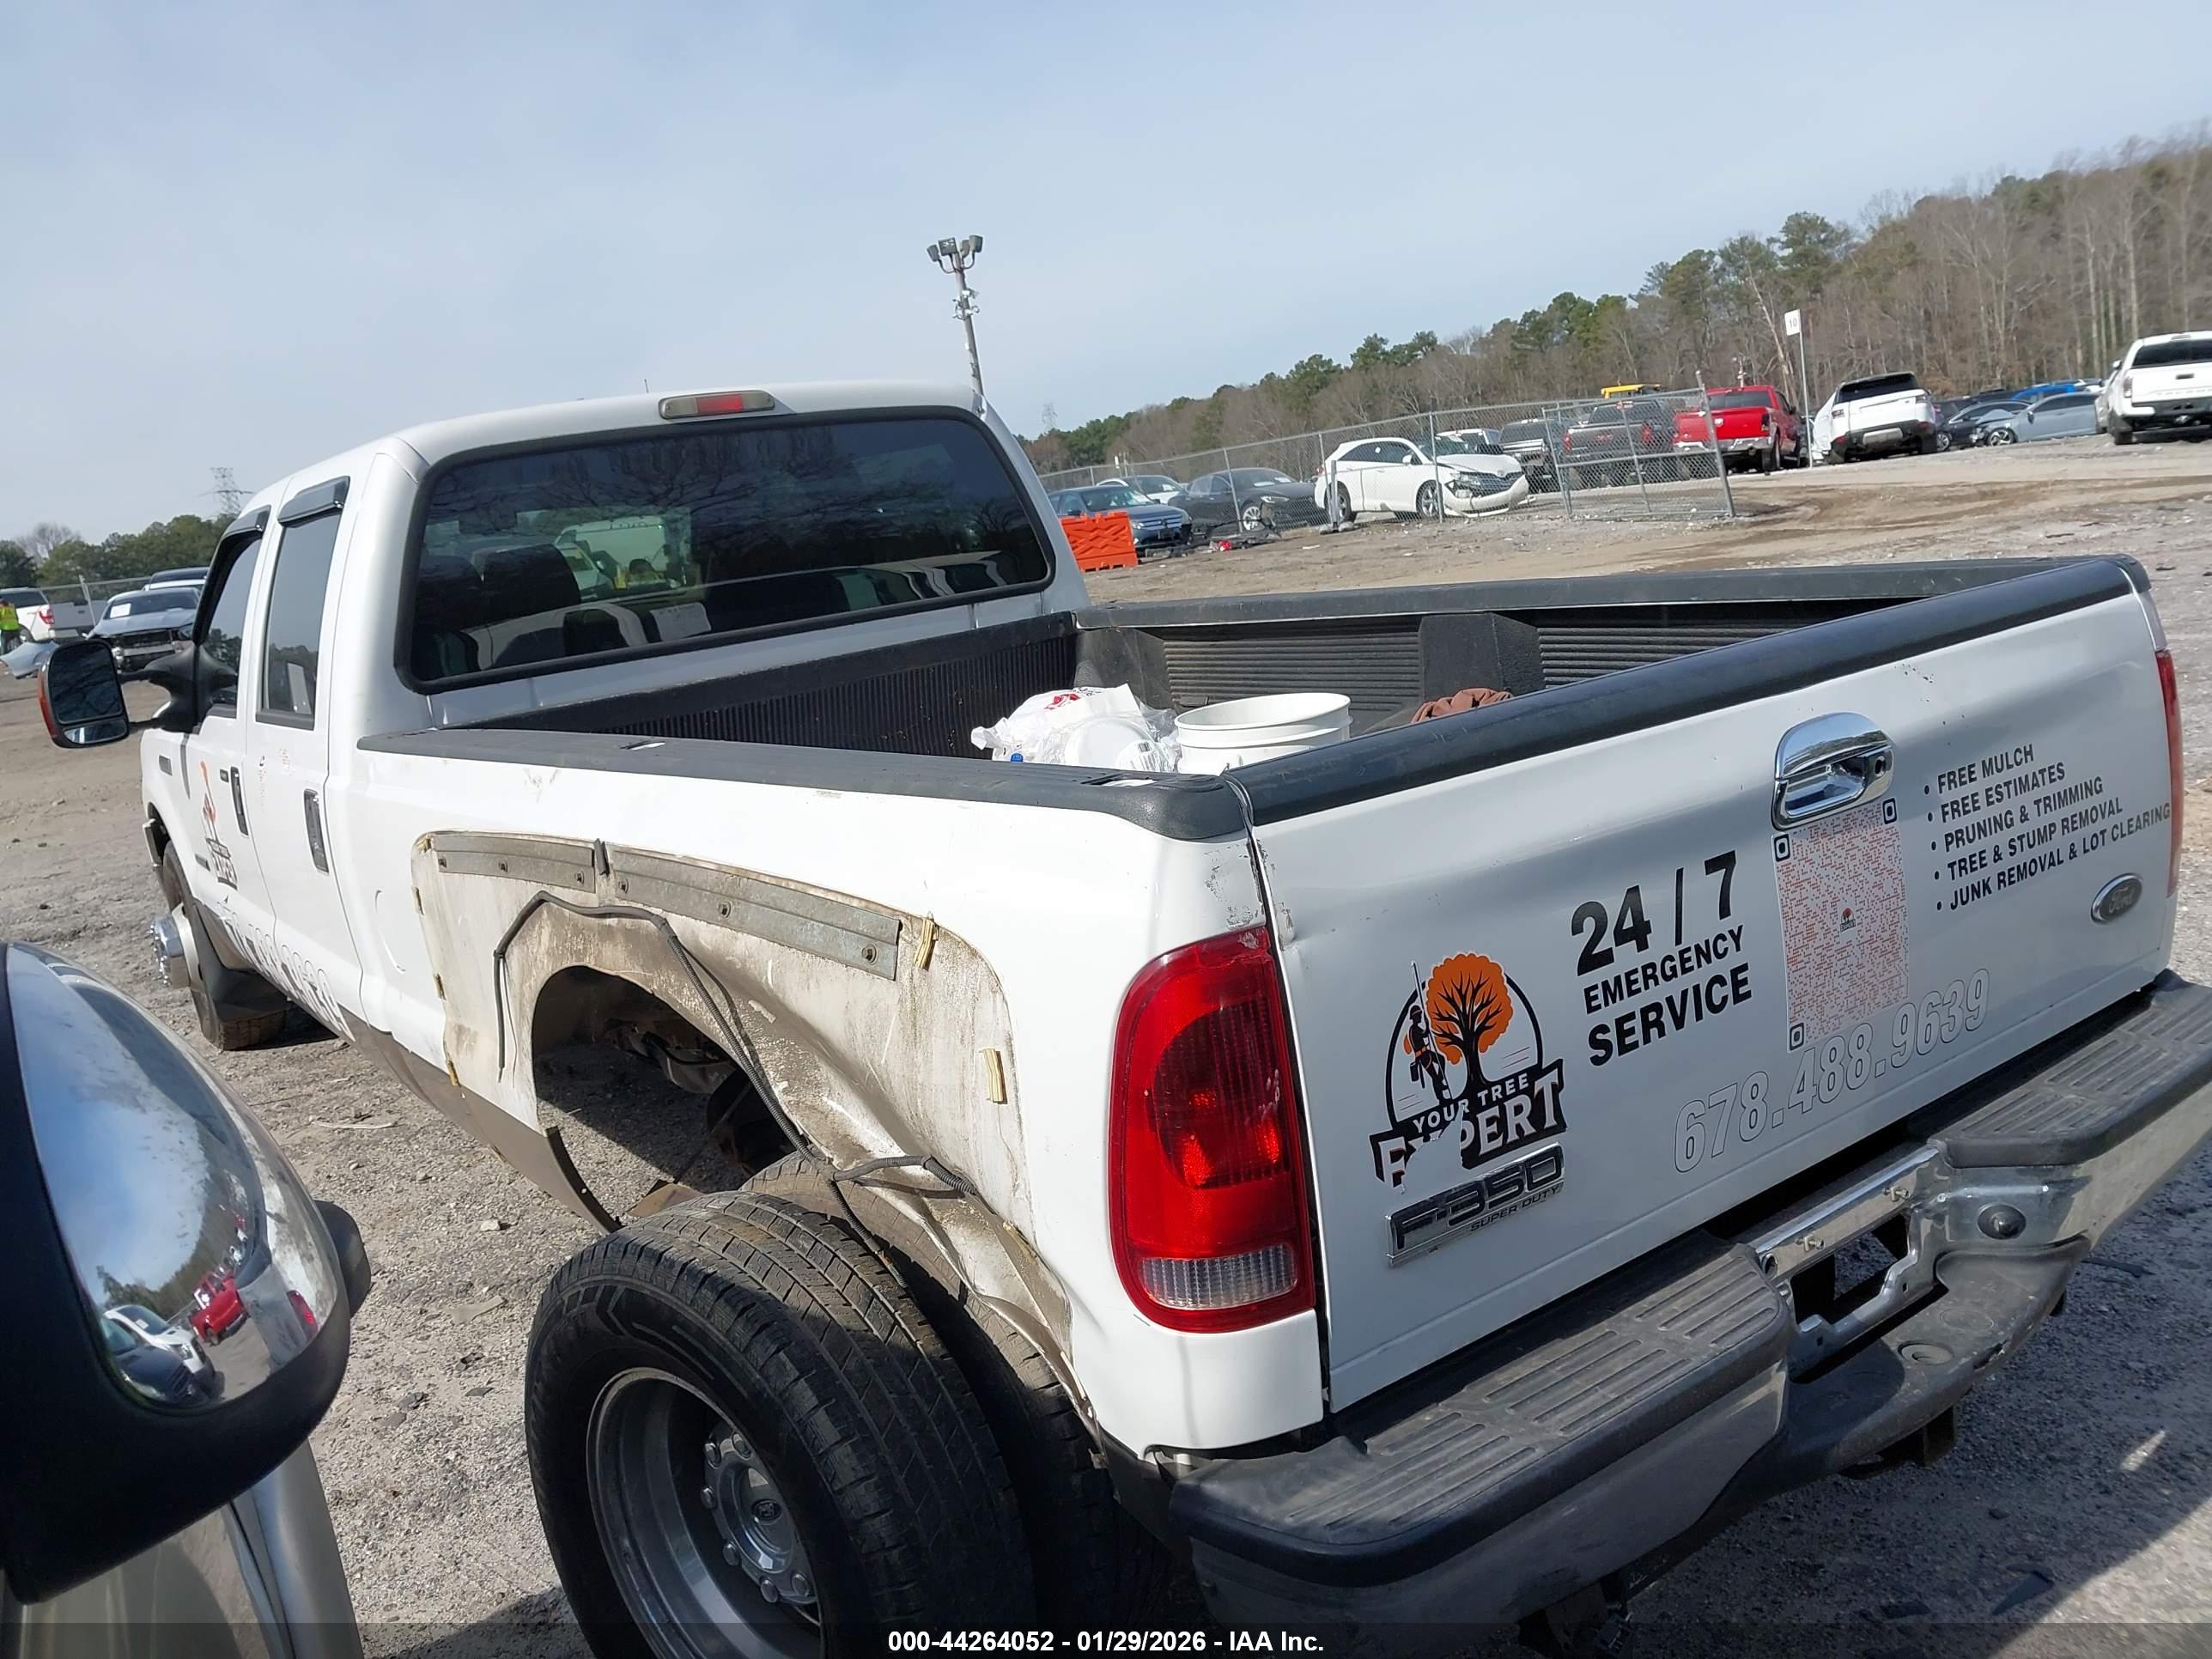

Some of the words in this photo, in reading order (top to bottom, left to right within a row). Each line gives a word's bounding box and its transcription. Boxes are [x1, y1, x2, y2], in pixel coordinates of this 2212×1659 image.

[1789, 318, 1797, 328] 10
[1938, 763, 1978, 794] FREE
[1981, 744, 2034, 779] MULCH
[1941, 792, 1981, 823] FREE
[1984, 762, 2066, 807] ESTIMATES
[1944, 809, 2014, 853] PRUNING
[2020, 805, 2030, 824] &
[2033, 776, 2103, 817] TRIMMING
[1947, 849, 1988, 881] TREE
[1993, 844, 2003, 864] &
[2008, 822, 2057, 857] STUMP
[2061, 797, 2124, 836] REMOVAL
[1950, 876, 1992, 910] JUNK
[1996, 848, 2064, 891] REMOVAL
[2069, 842, 2078, 860] &
[2082, 829, 2107, 855] LOT
[2111, 802, 2172, 842] CLEARING
[1571, 884, 1652, 976] 24
[1704, 849, 1736, 921] 7
[1583, 924, 1743, 1015] EMERGENCY
[1589, 962, 1752, 1066] SERVICE
[1413, 1098, 1470, 1133] YOUR
[1477, 1073, 1529, 1108] TREE
[1674, 968, 1990, 1174] 678.488.9639
[1469, 1203, 1518, 1231] SUPER
[1522, 1186, 1561, 1208] DUTY
